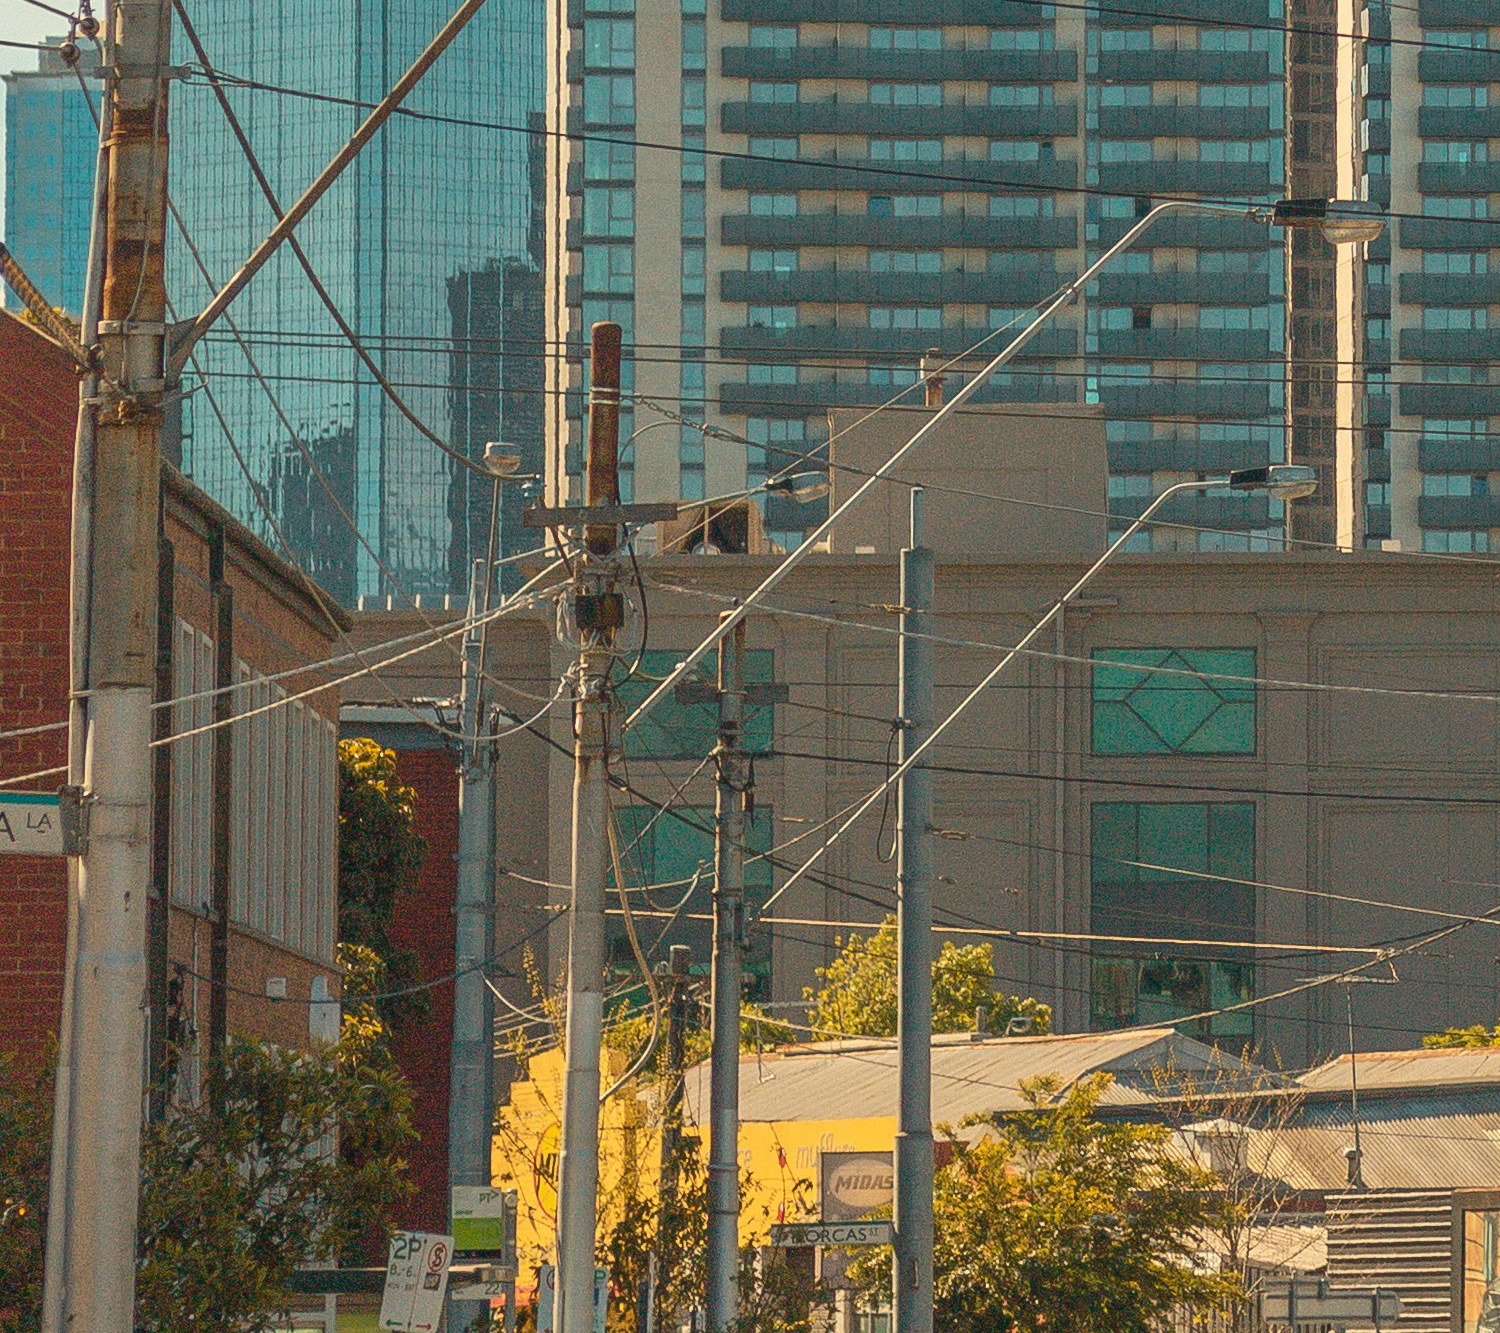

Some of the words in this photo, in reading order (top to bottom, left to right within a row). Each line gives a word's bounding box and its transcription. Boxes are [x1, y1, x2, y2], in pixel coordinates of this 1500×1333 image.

[26, 812, 52, 829] LA
[835, 1174, 894, 1193] MIDAS
[393, 1236, 422, 1261] 2P
